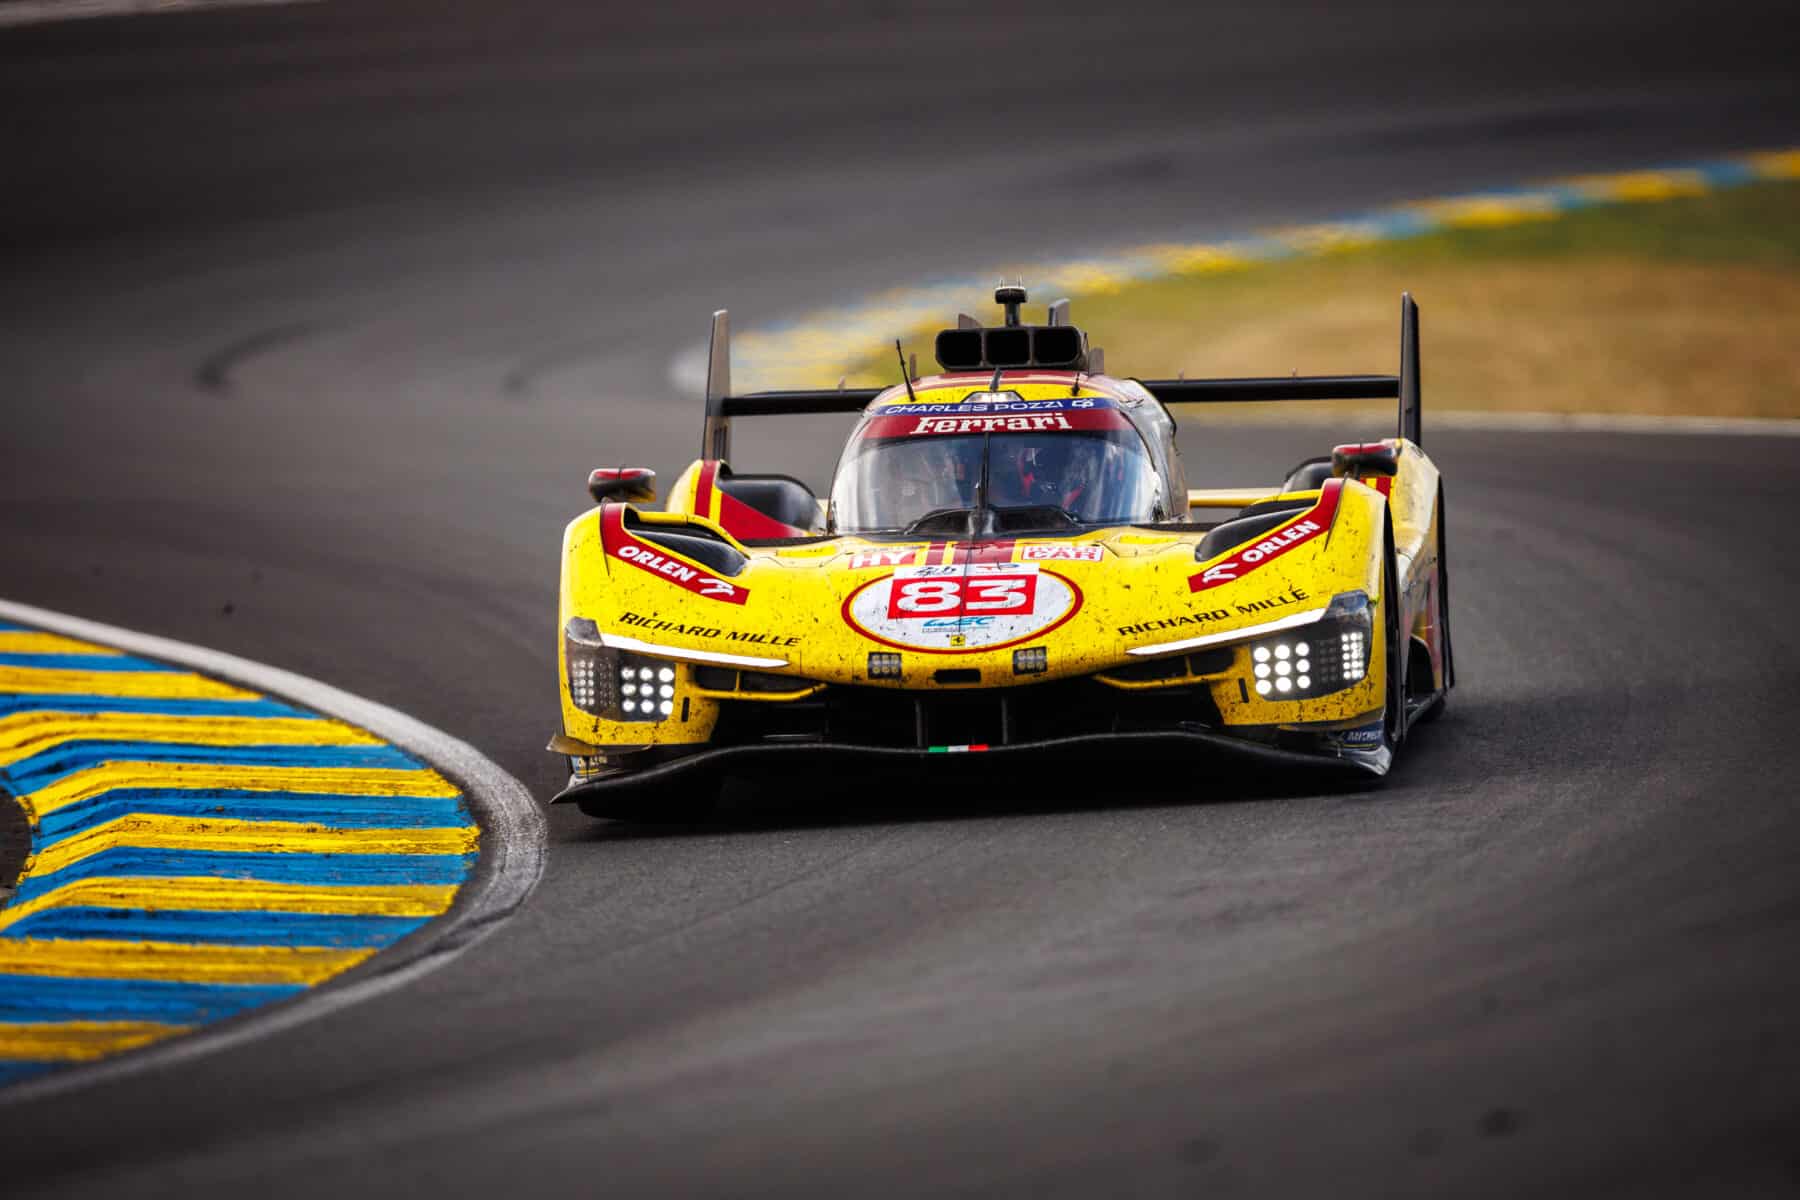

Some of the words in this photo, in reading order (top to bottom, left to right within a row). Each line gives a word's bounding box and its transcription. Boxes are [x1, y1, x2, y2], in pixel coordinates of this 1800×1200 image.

[885, 404, 988, 415] CHARLES
[994, 401, 1064, 411] POZZI
[910, 413, 1072, 434] Ferrari
[1027, 551, 1097, 559] CAR
[1241, 520, 1321, 563] ORLEN
[618, 546, 699, 582] ORLEN
[897, 580, 1027, 612] 83
[1117, 609, 1230, 636] RICHARD
[1236, 587, 1310, 615] MILLE
[619, 611, 721, 638] RICHARD
[725, 631, 802, 647] MILLE
